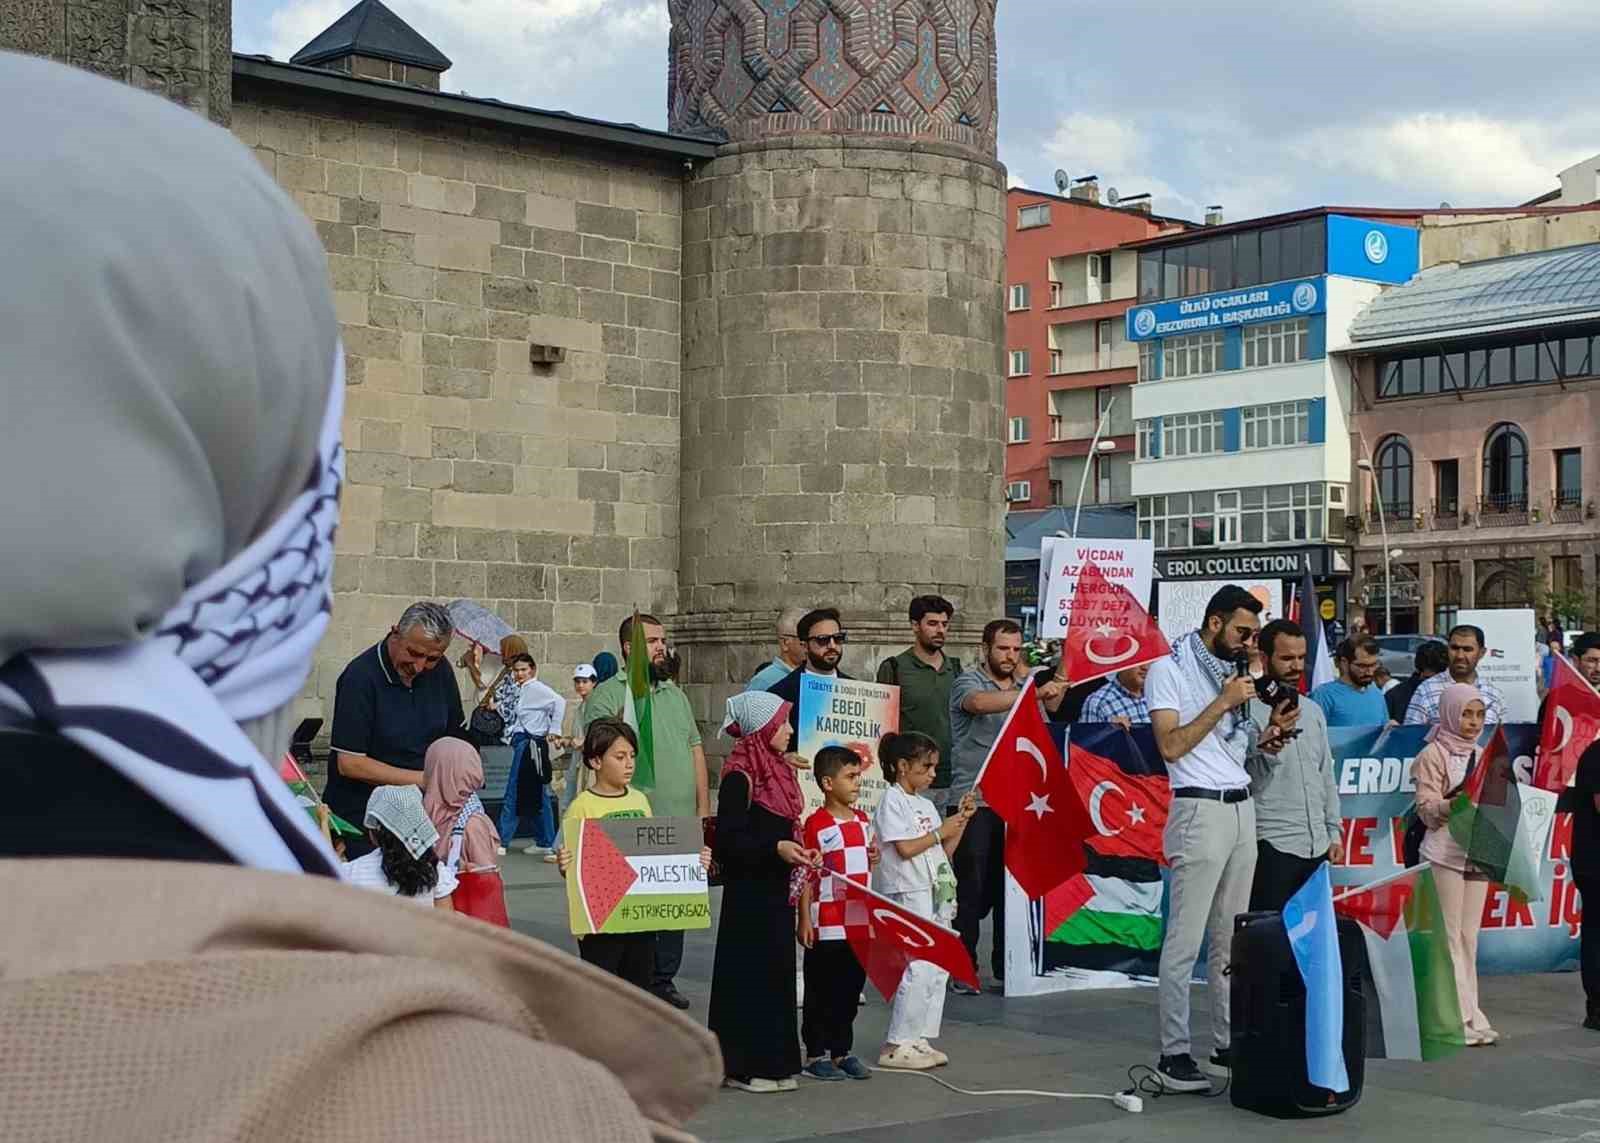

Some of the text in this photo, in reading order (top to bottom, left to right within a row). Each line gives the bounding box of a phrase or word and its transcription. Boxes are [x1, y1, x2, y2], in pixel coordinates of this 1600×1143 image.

[1180, 290, 1269, 314] ÜLKÜ OCAKLARI
[1156, 316, 1208, 333] ERZURUM
[1222, 301, 1291, 323] BAŞKANLIĞI
[1077, 547, 1124, 560] VİCDAN
[1167, 555, 1298, 576] EROL COLLECTION
[832, 698, 866, 717] EBEDİ
[816, 715, 881, 738] KARDEŞLİK
[636, 826, 679, 846] FREE
